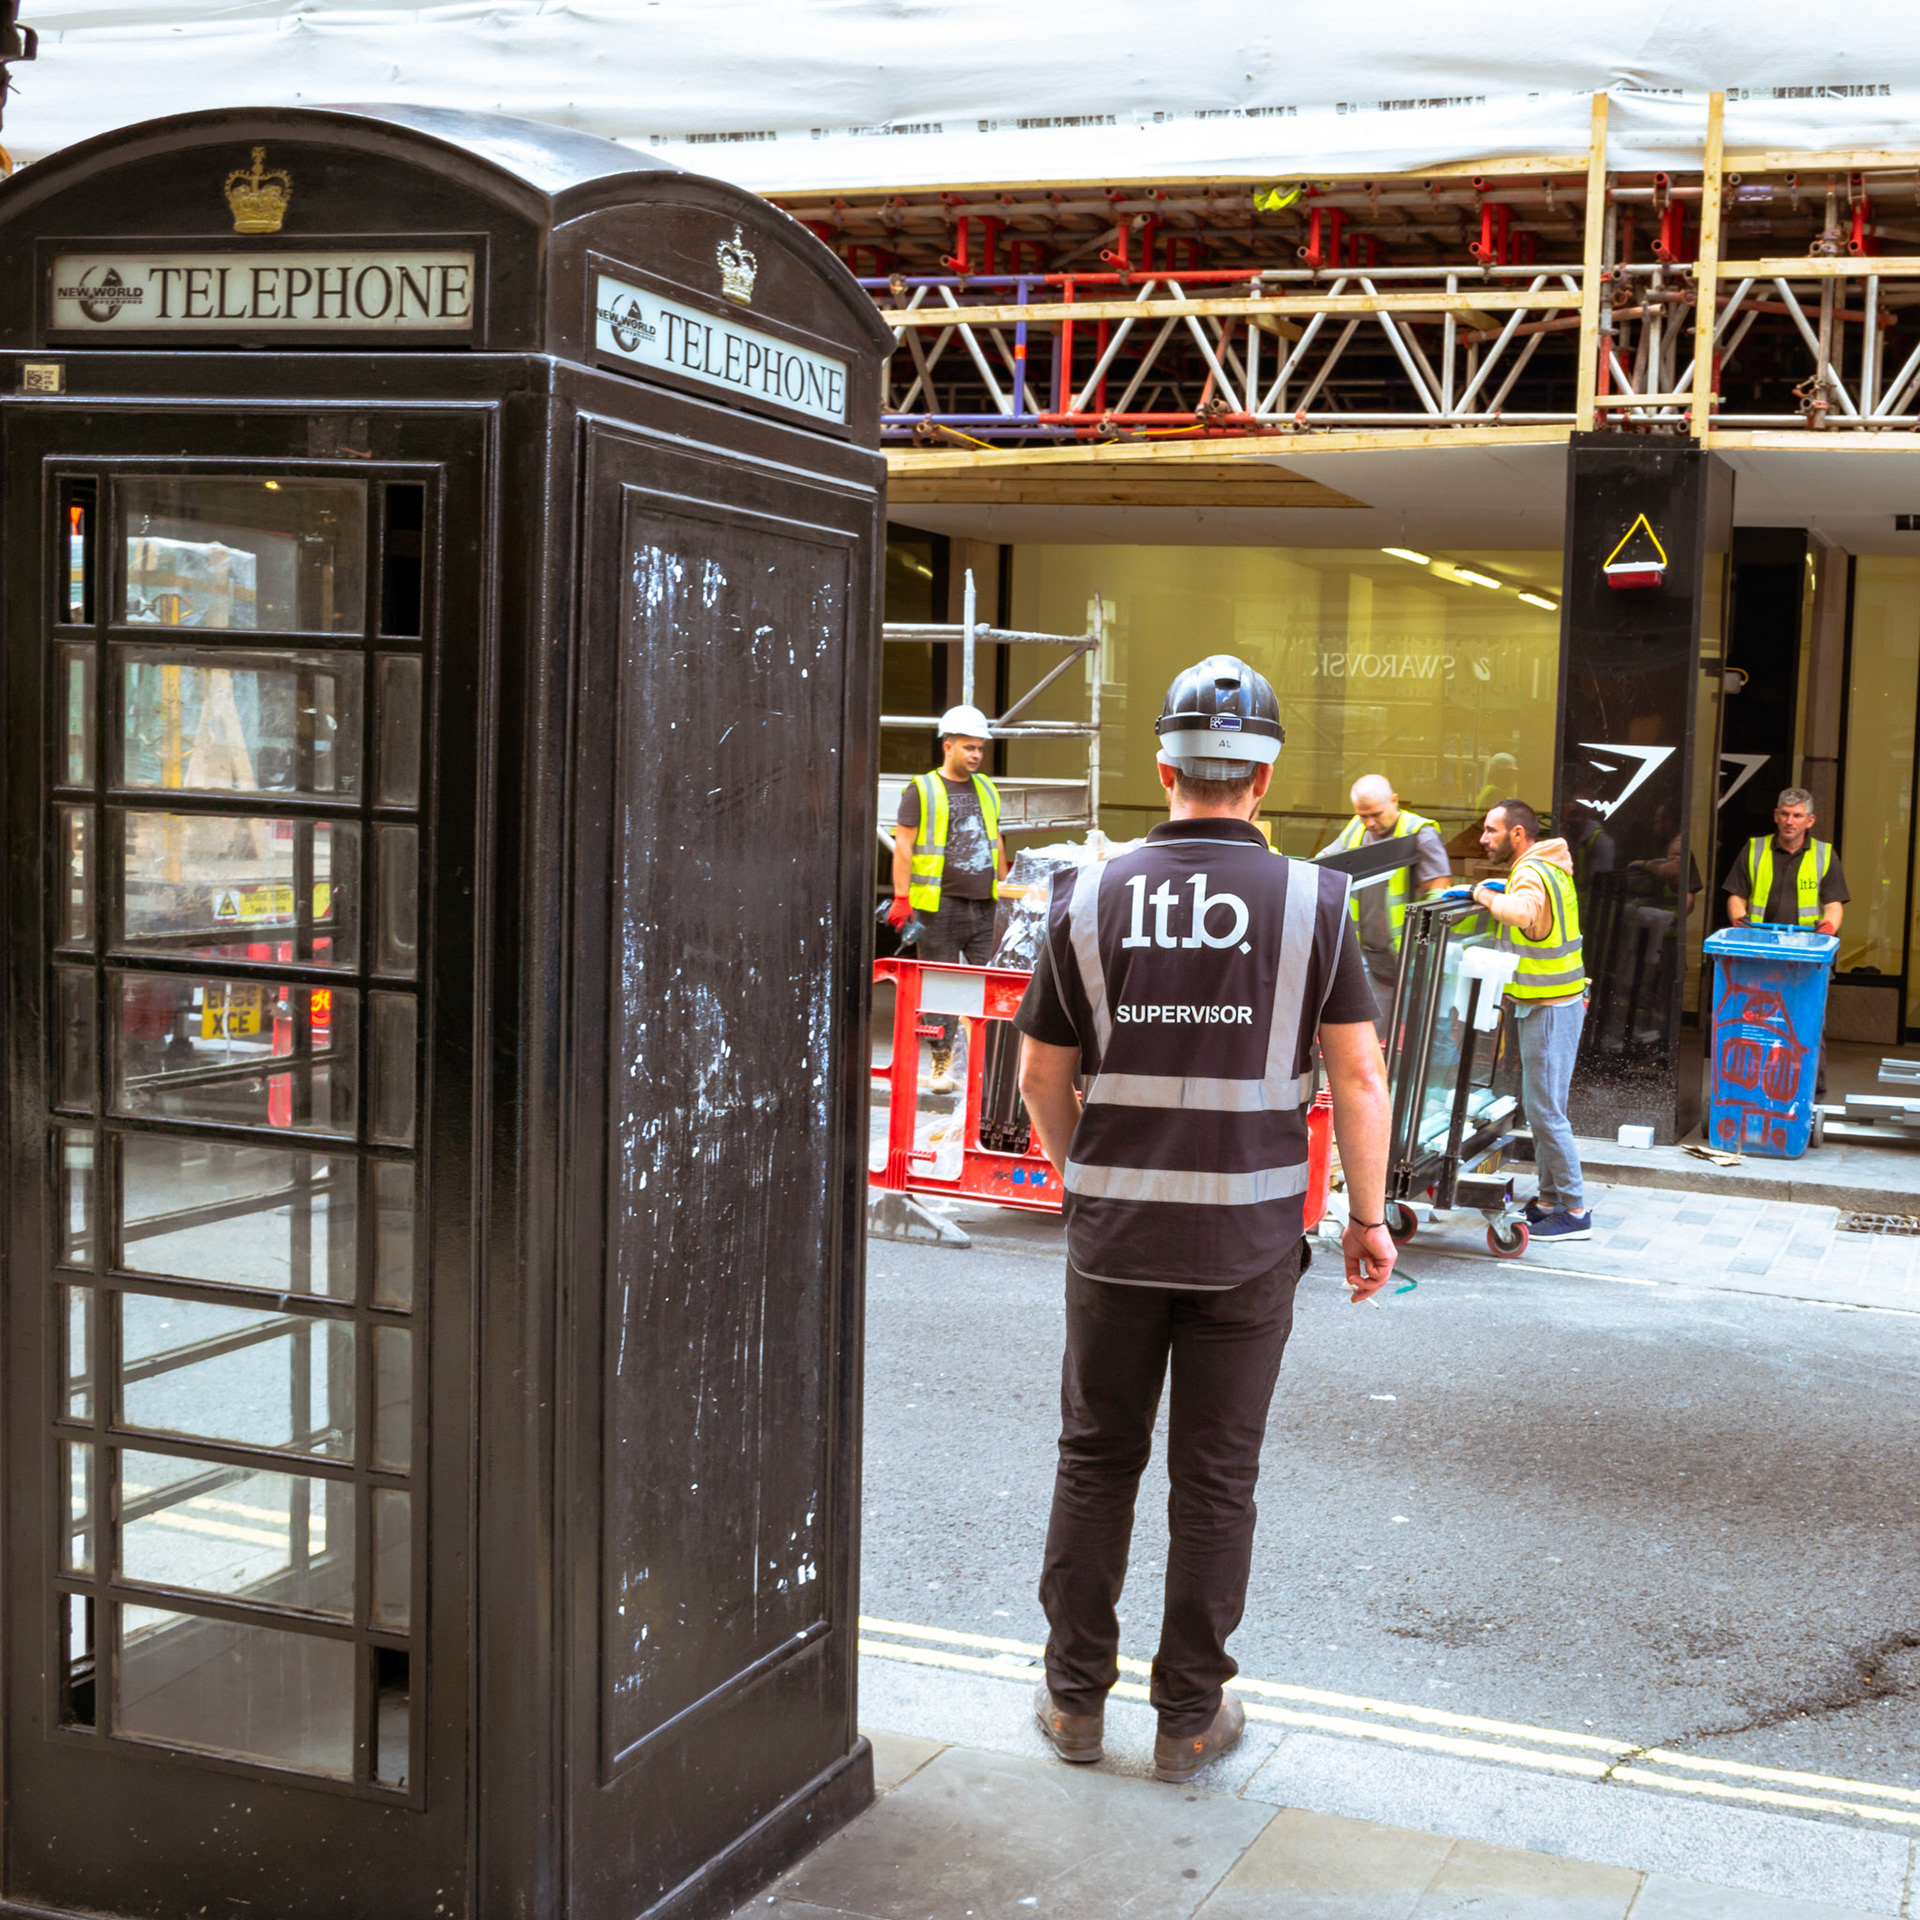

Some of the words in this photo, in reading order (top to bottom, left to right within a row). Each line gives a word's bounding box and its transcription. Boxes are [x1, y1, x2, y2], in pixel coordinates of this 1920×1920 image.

[58, 287, 90, 297] NEW
[93, 287, 144, 297] WORLD
[149, 265, 470, 319] TELEPHONE
[597, 307, 619, 322] NEW
[621, 315, 657, 335] WORLD
[660, 310, 844, 414] TELEPHONE
[212, 1011, 251, 1035] XCE
[1116, 1004, 1253, 1024] SUPERVISOR
